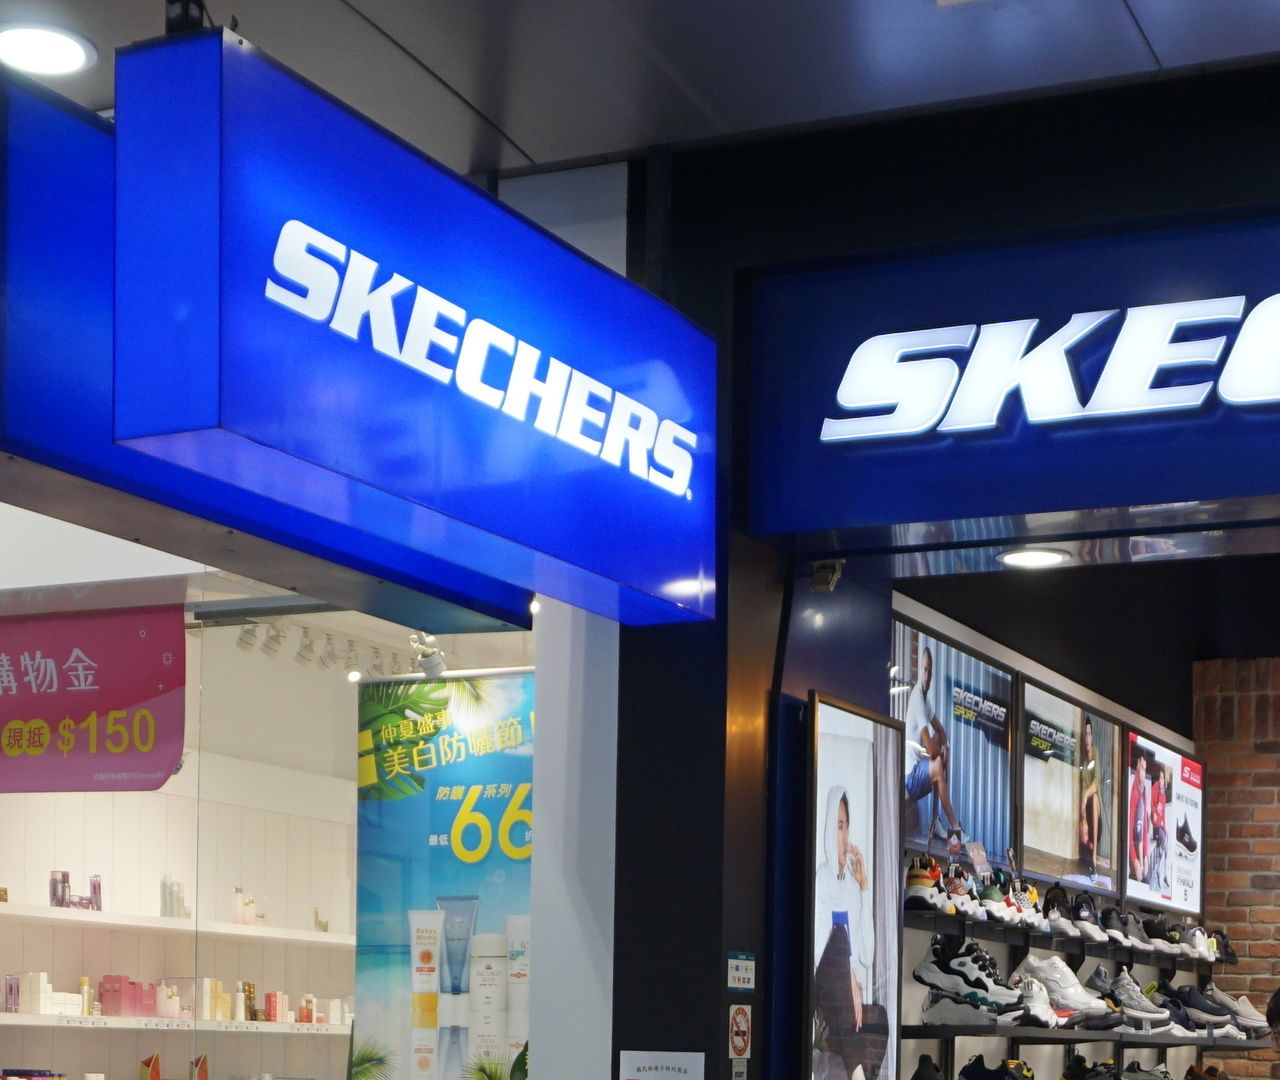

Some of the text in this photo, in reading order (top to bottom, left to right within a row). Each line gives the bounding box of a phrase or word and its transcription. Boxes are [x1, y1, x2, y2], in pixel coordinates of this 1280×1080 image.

[264, 218, 699, 502] SKECHERS
[952, 686, 1007, 721] SKECHERS
[954, 704, 977, 721] SPORT
